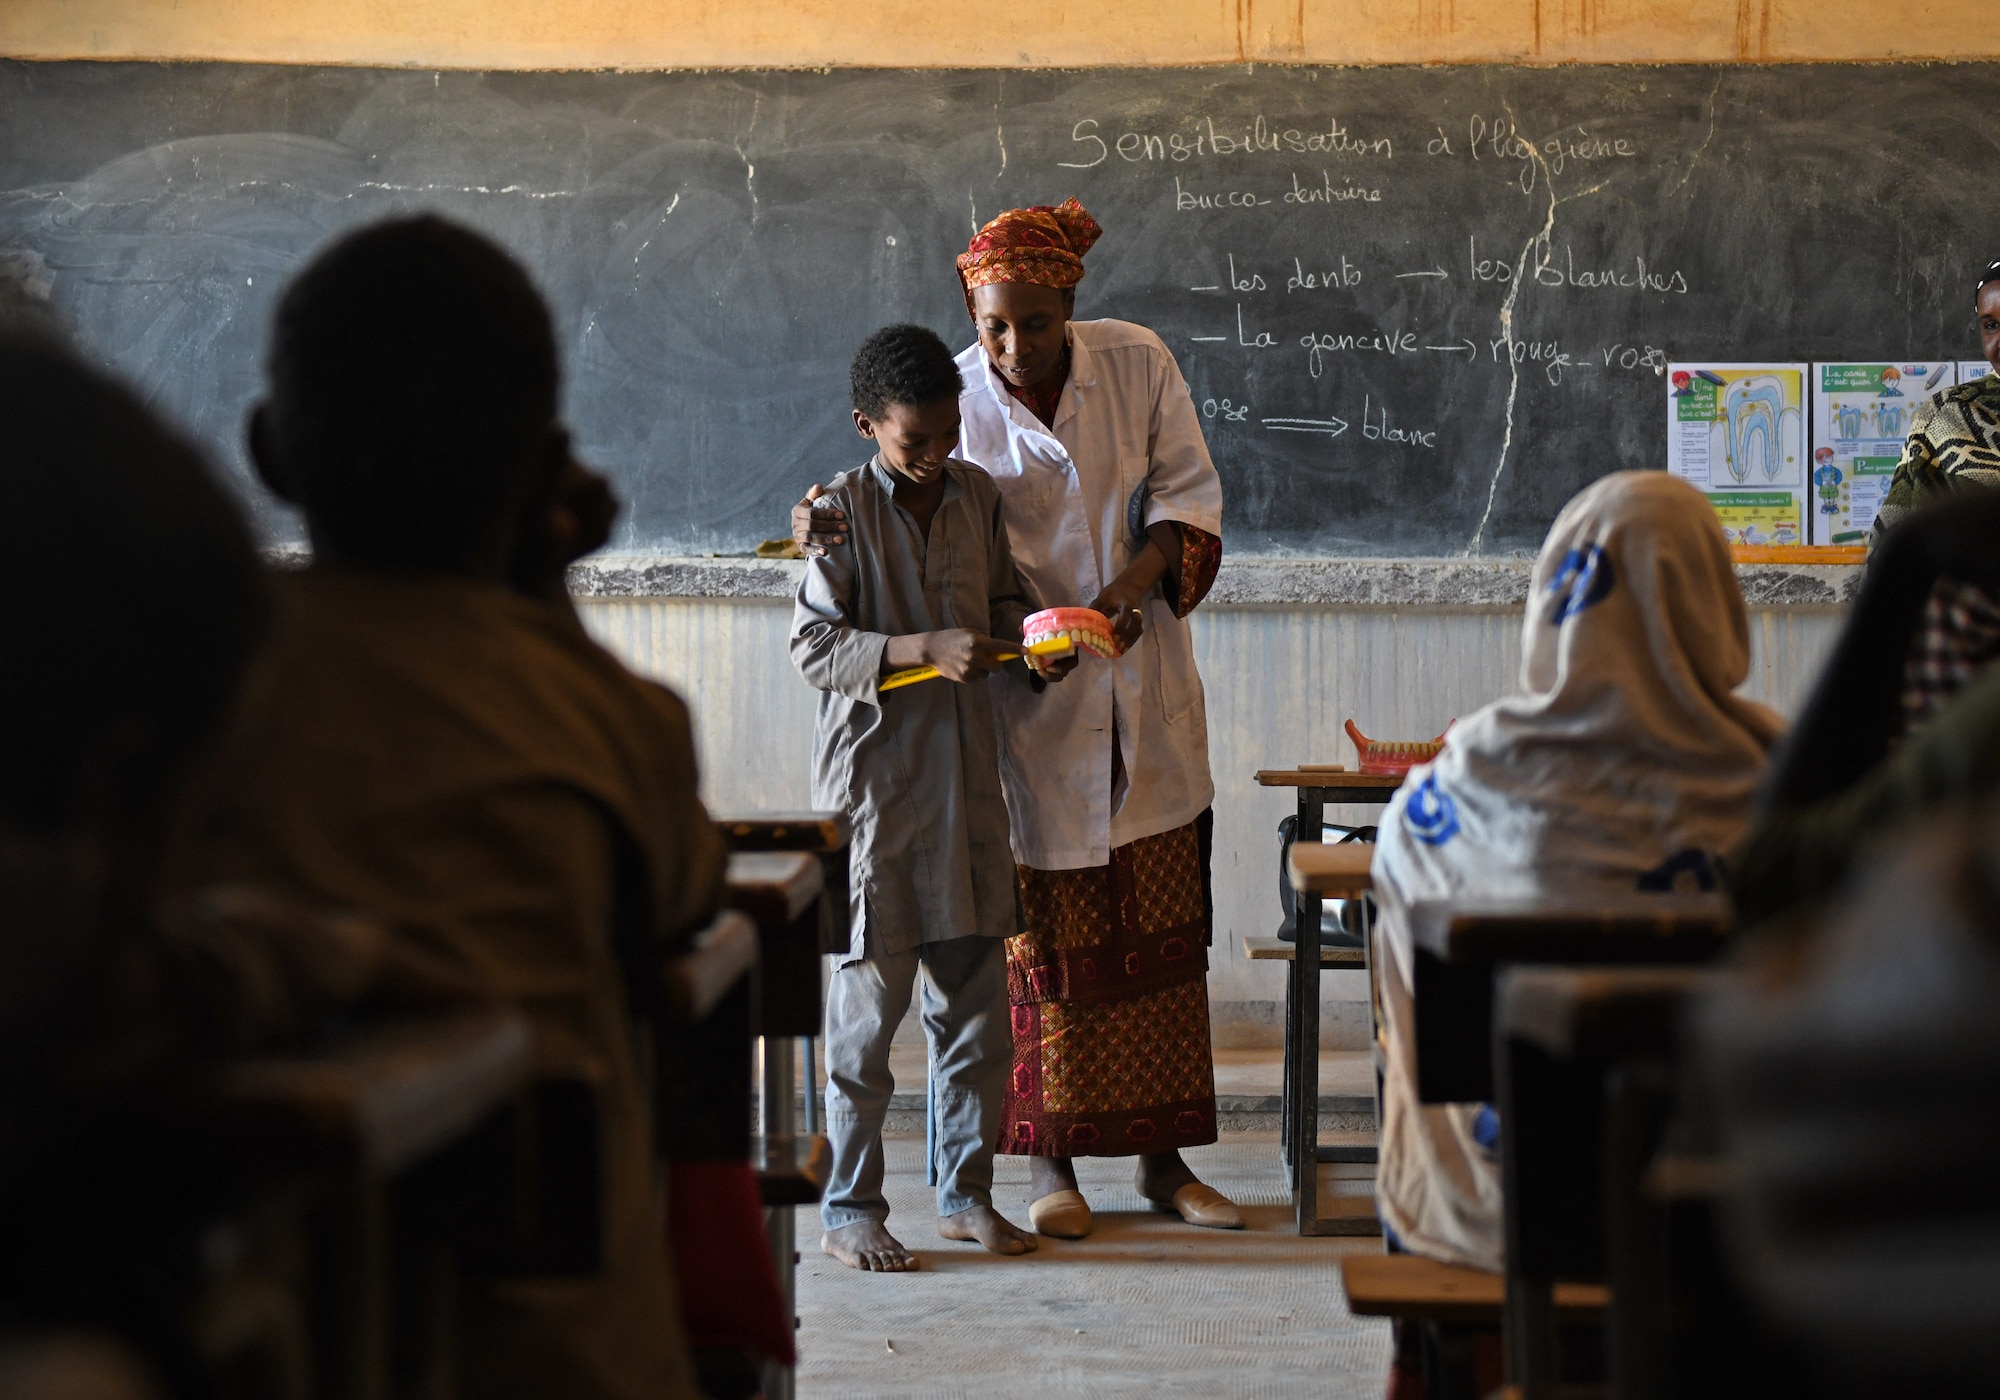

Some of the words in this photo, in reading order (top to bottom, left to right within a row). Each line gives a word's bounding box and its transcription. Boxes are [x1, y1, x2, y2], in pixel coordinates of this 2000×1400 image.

[1057, 115, 1392, 167] Sensibilisation
[1427, 126, 1453, 155] à
[1237, 302, 1279, 348] La
[1826, 366, 1841, 378] La
[1970, 368, 1986, 378] UNE
[1362, 393, 1437, 448] blanc
